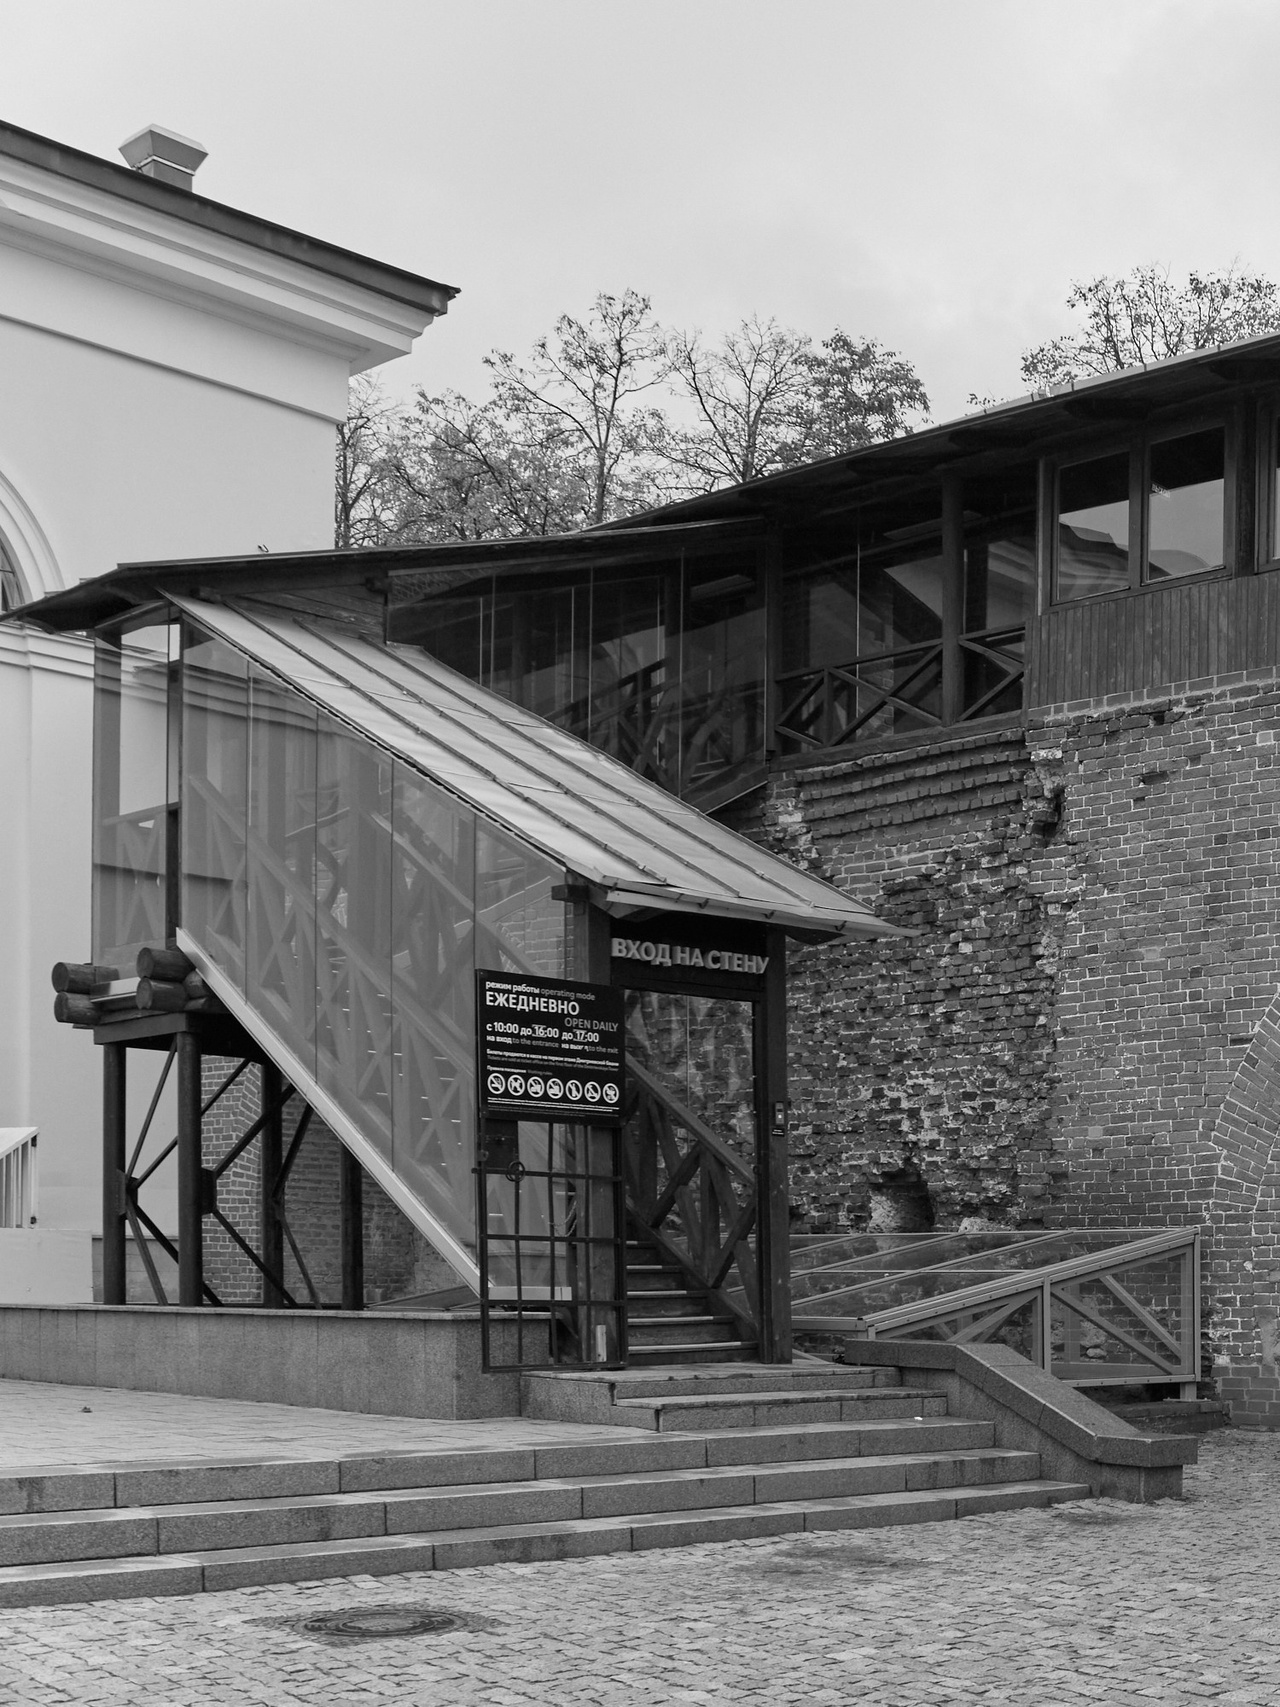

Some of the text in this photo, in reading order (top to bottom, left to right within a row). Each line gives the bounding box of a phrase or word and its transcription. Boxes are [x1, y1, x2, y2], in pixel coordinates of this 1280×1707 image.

[611, 937, 769, 974] ВХОД НА СТЕНУ
[485, 981, 540, 994] режим работы
[541, 988, 596, 1001] operating mode
[486, 991, 580, 1016] ЕЖЕДНЕВНО
[493, 1021, 519, 1034] 10:00
[520, 1026, 533, 1036] до
[533, 1026, 560, 1038] 16:00
[562, 1031, 574, 1041] до
[574, 1030, 600, 1043] 17:00
[564, 1017, 619, 1032] OPEN DAILY
[496, 1036, 512, 1044] вход
[520, 1037, 531, 1045] the
[532, 1039, 559, 1048] entrance
